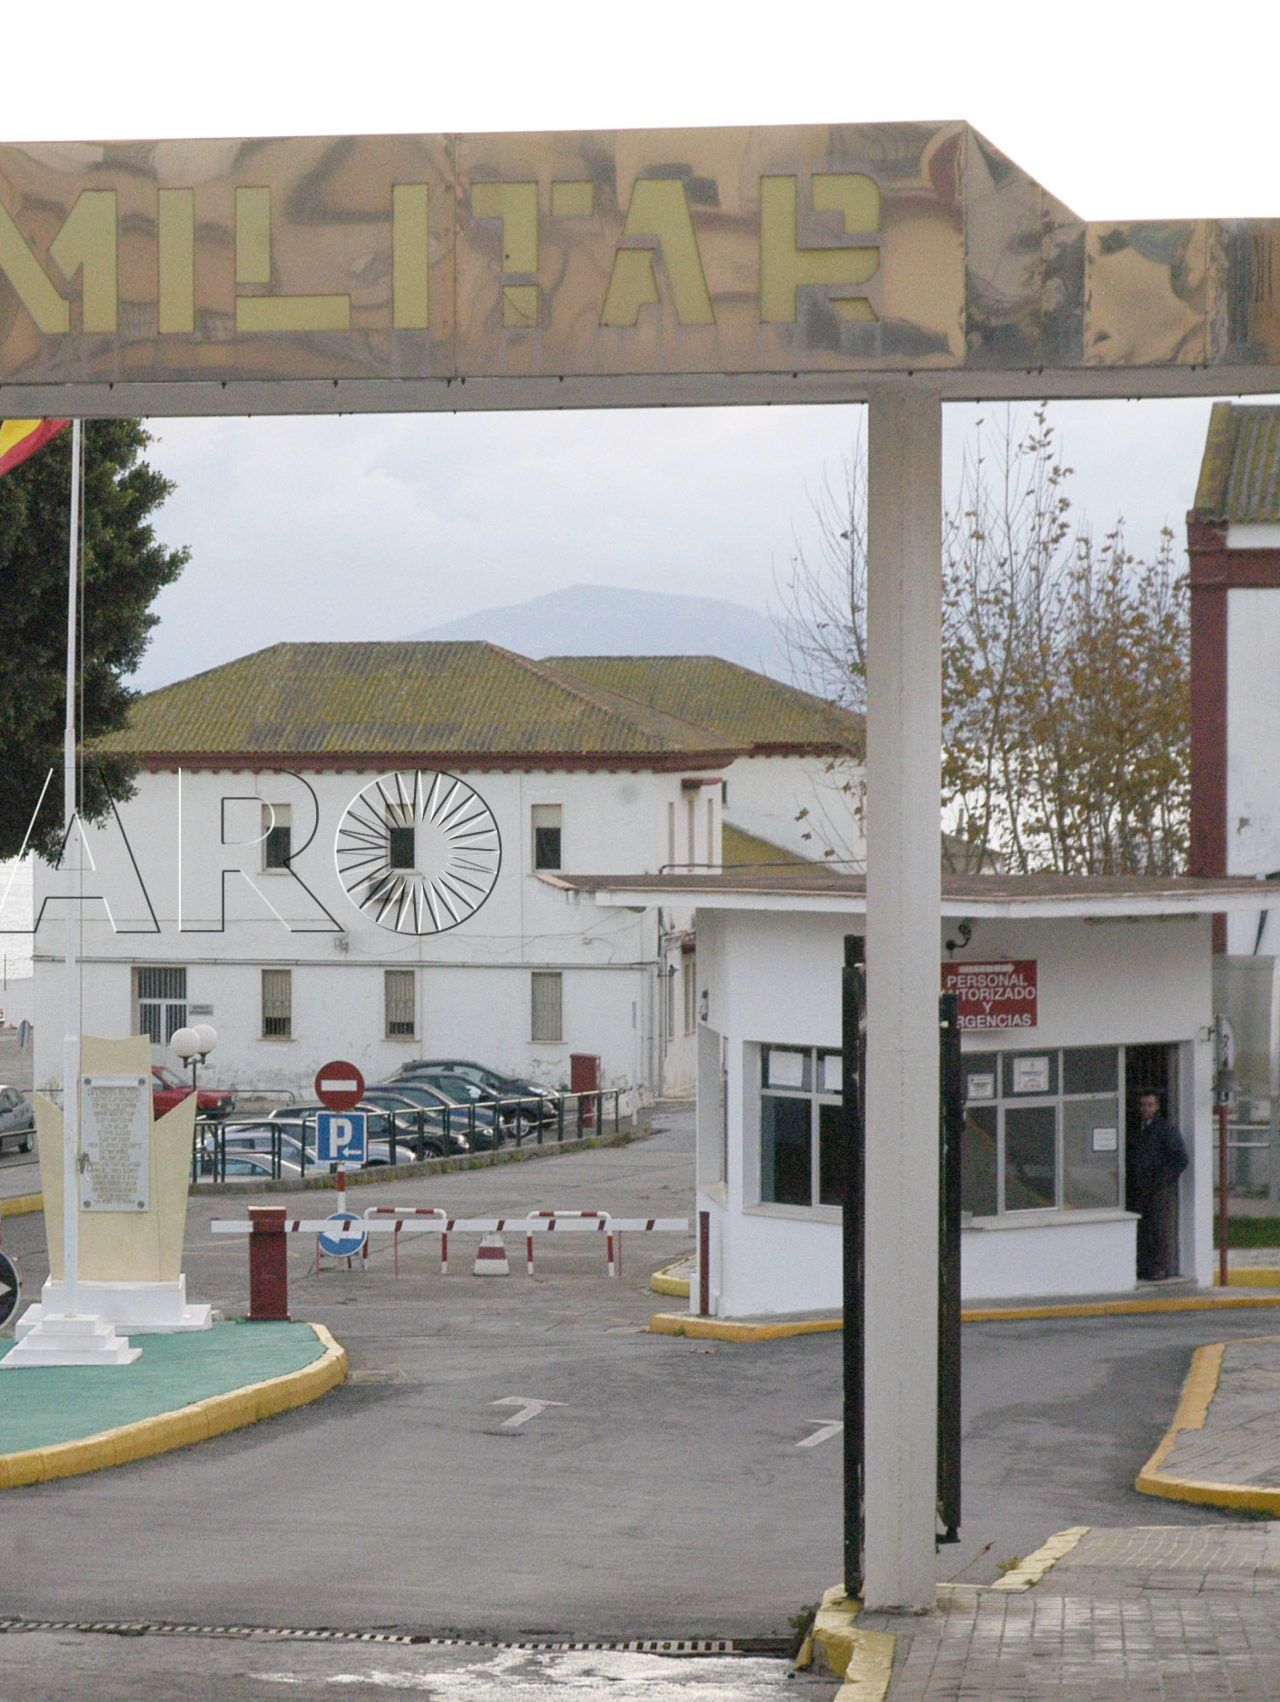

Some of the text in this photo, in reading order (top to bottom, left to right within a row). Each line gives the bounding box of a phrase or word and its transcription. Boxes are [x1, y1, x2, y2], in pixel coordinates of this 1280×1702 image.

[946, 973, 1028, 987] PERSONAL
[940, 986, 1036, 1001] TORIZADO
[982, 1001, 993, 1014] Y
[957, 1013, 1032, 1028] RGENCIAS
[329, 1117, 353, 1158] P
